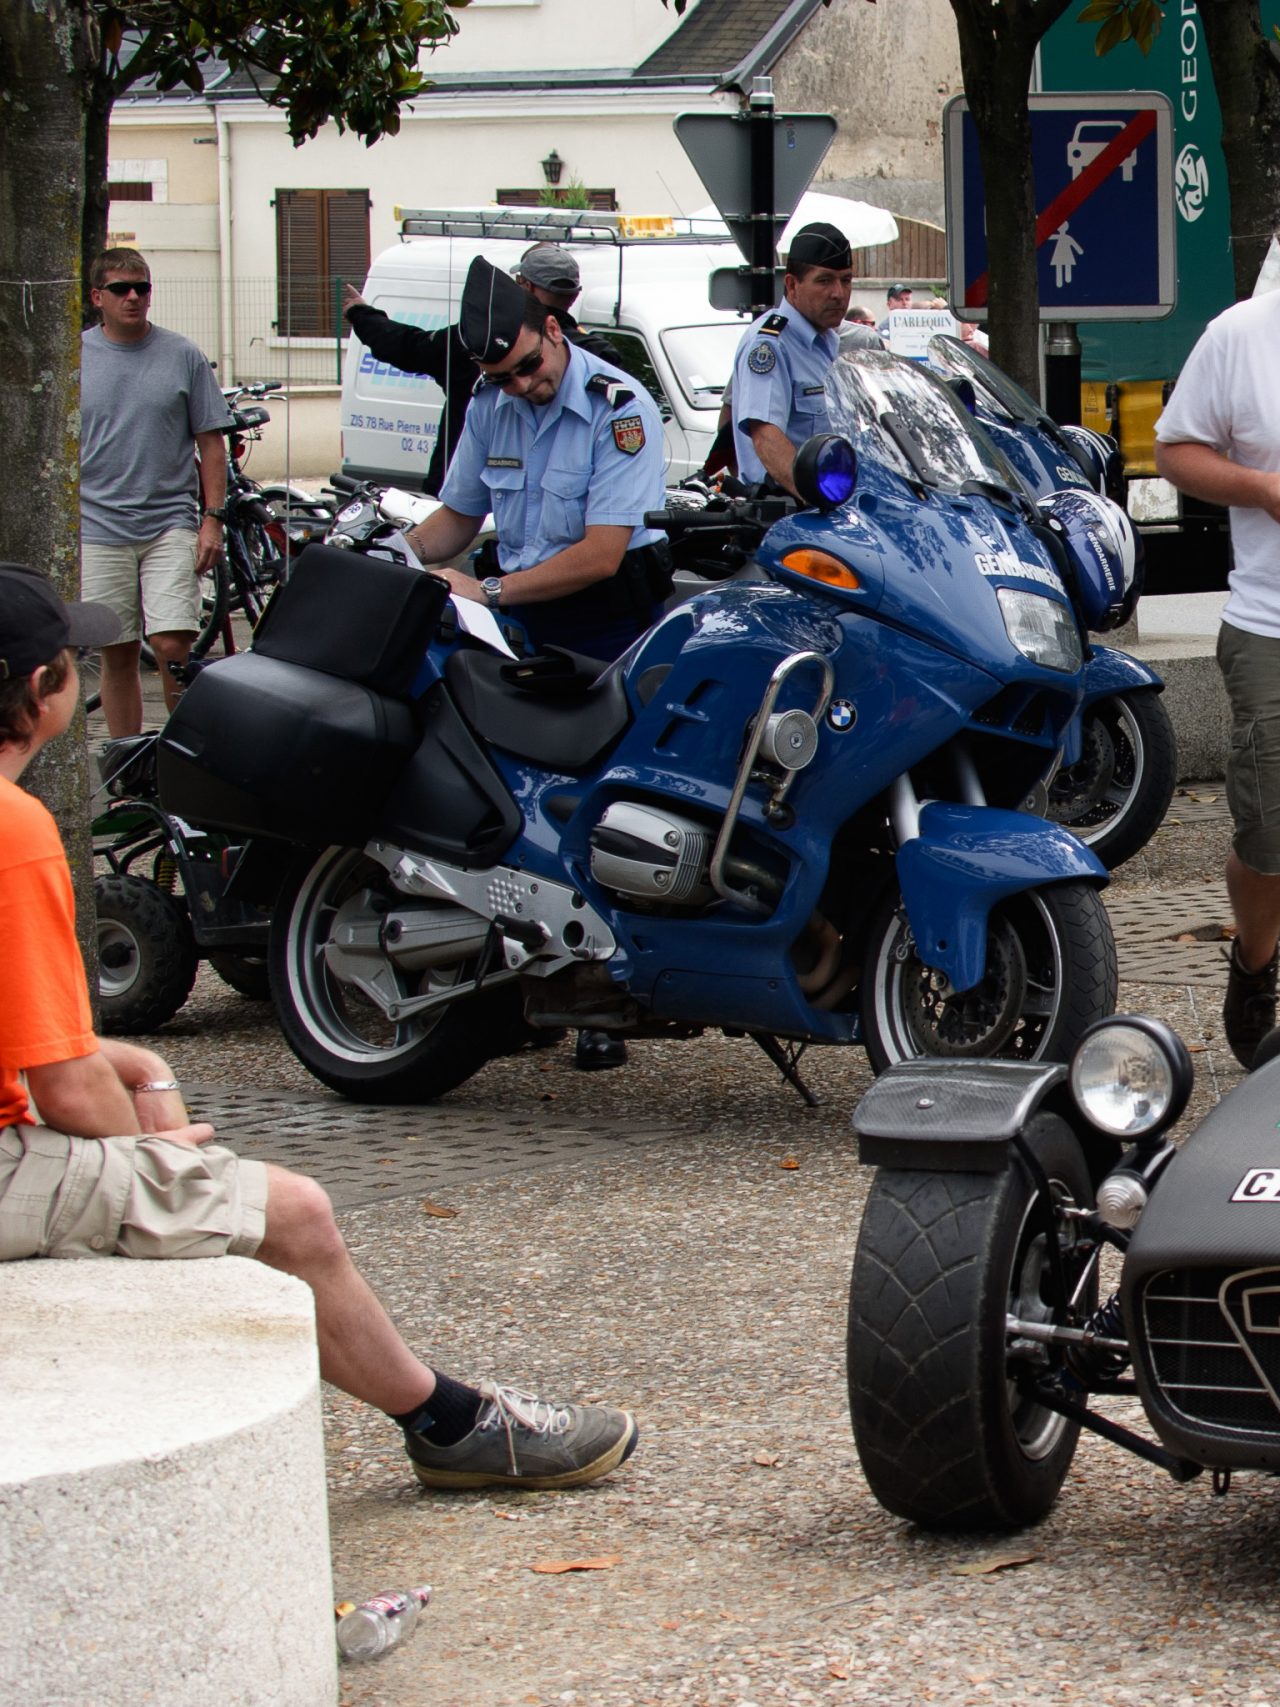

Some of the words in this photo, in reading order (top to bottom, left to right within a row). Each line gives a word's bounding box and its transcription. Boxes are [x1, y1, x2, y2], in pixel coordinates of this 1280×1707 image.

[893, 315, 952, 331] L'ARLEQUIN
[366, 416, 377, 429] 78
[379, 417, 394, 432] Rue
[397, 419, 421, 434] Pierre
[401, 437, 414, 452] 02
[416, 440, 429, 453] 43
[1086, 531, 1117, 592] GENDARMERIE
